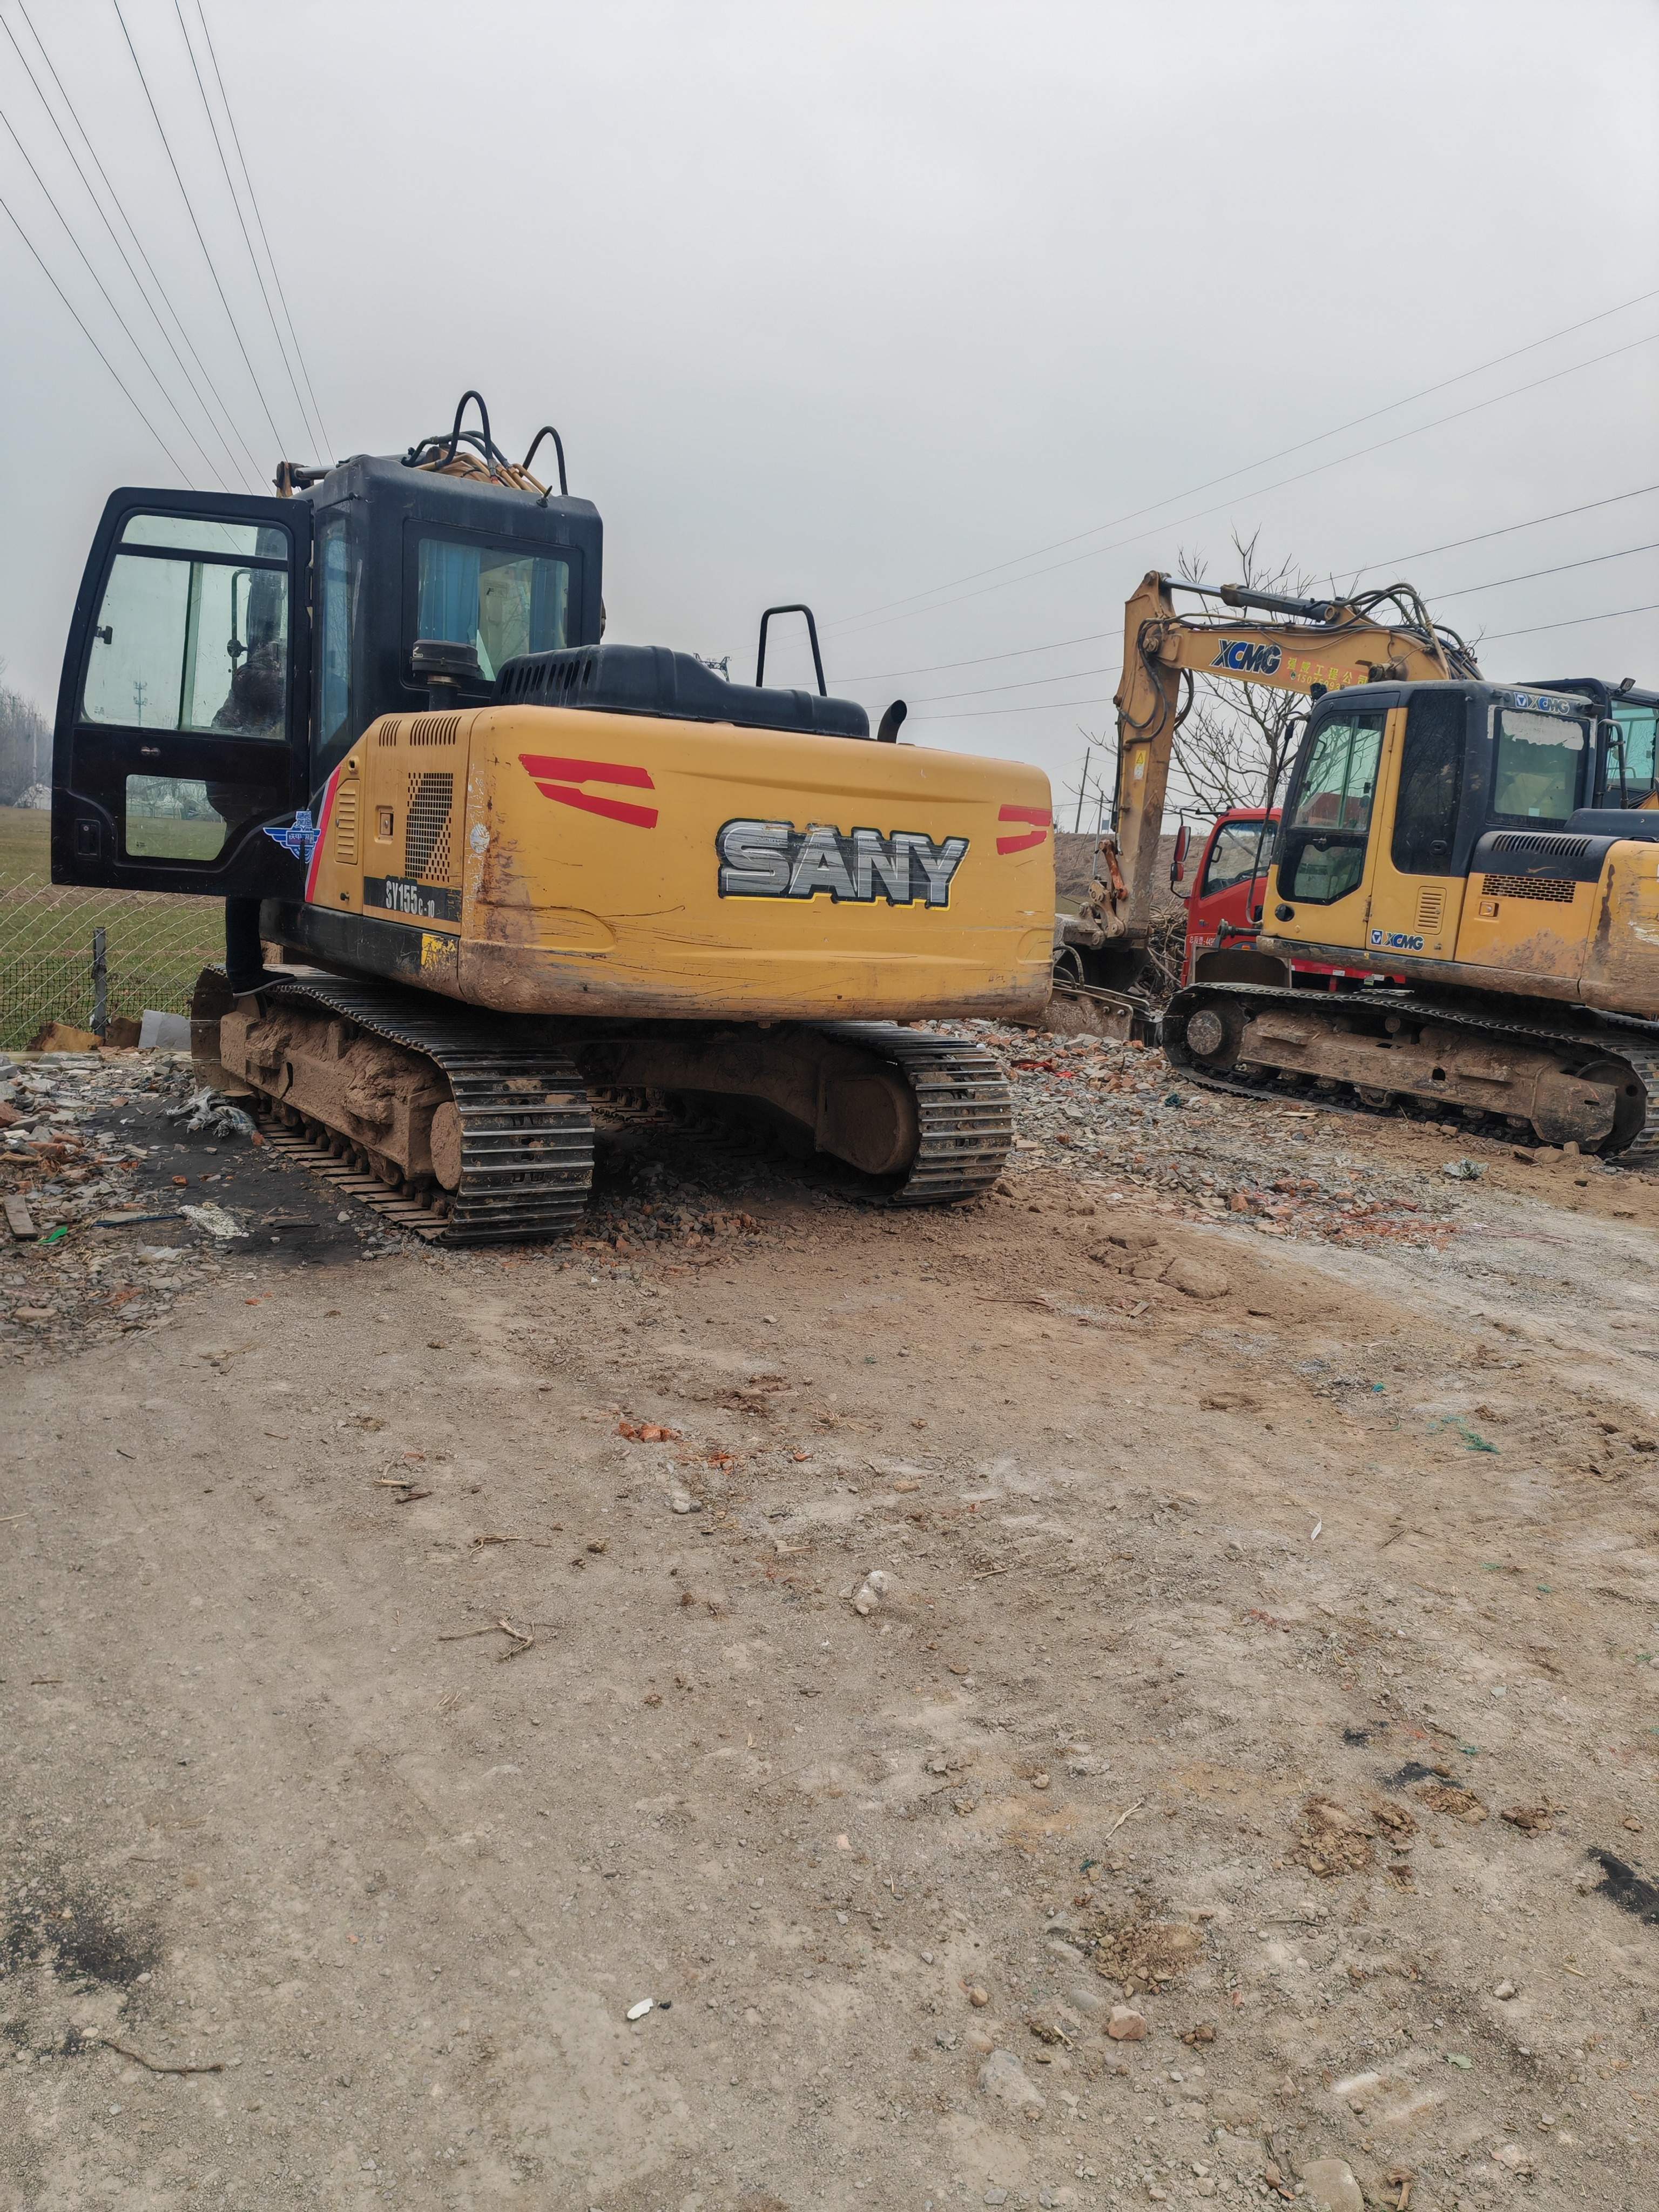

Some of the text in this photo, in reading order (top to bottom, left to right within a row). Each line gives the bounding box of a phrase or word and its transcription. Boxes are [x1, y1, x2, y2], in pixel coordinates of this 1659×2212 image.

[1209, 639, 1282, 675] XCMG
[1528, 693, 1570, 714] XCMG
[716, 818, 970, 911] SANY
[1382, 931, 1425, 952] XCMG
